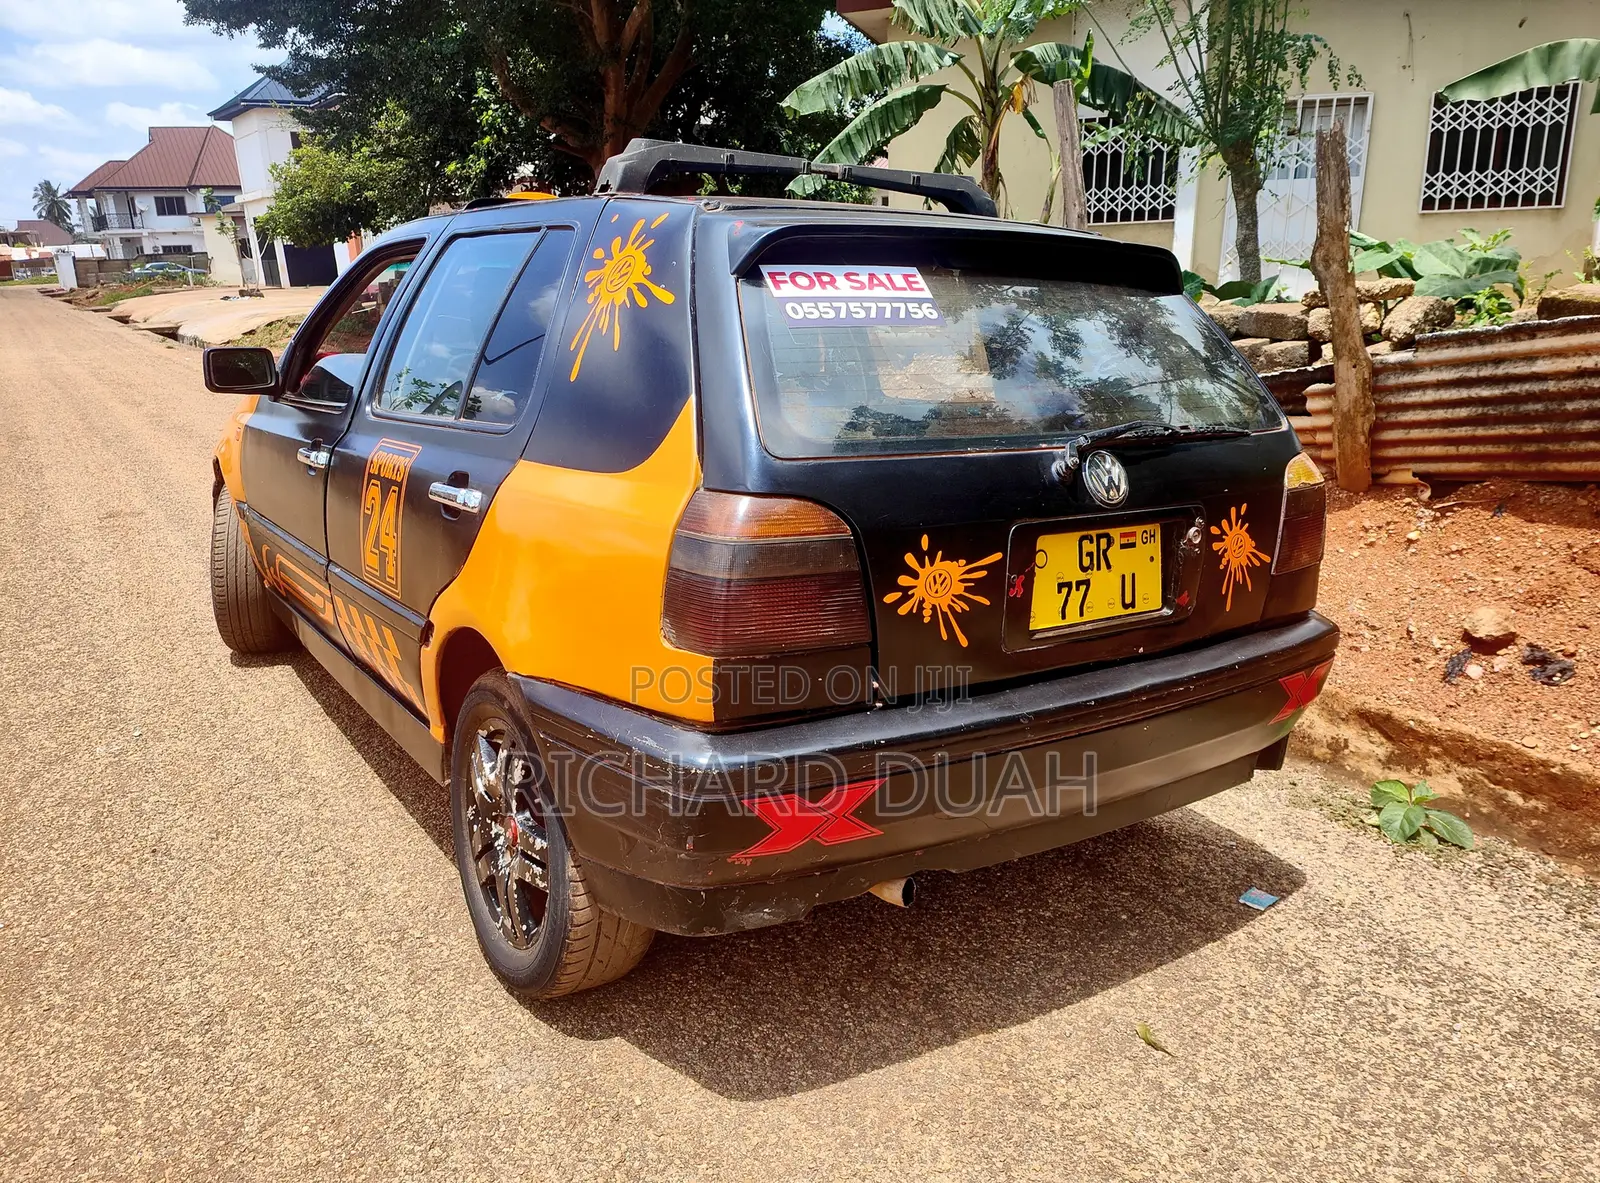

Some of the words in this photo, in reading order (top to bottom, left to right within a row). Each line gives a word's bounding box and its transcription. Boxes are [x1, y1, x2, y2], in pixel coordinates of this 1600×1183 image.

[766, 271, 840, 291] FOR
[843, 272, 926, 292] SALE
[785, 302, 939, 320] 0557577756
[370, 451, 410, 483] SPORTS
[364, 479, 399, 585] 24
[1078, 532, 1114, 573] GR
[1141, 529, 1156, 545] GH
[1057, 579, 1091, 620] 77
[1121, 573, 1136, 610] U
